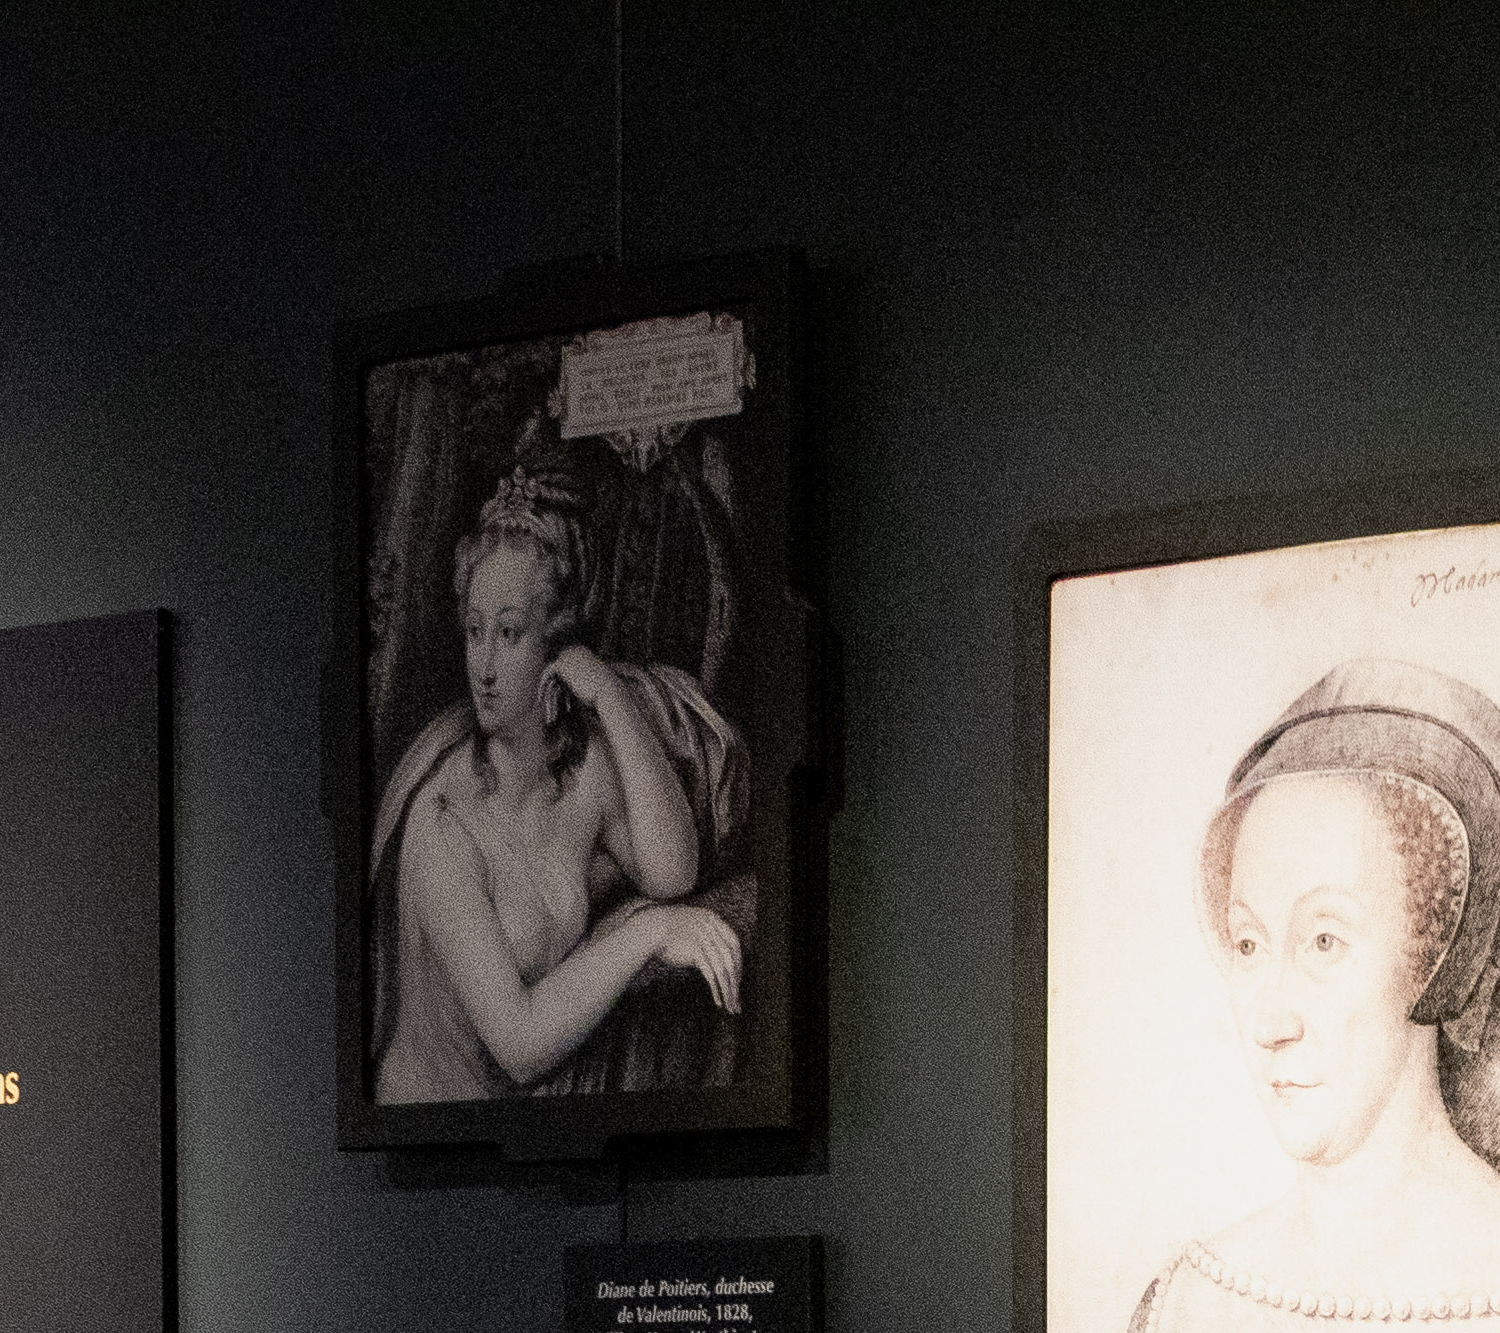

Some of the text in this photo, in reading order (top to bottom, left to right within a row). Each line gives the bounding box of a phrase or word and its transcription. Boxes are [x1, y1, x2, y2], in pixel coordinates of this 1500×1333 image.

[598, 1276, 774, 1298] Diane de Poitiers, duchesse
[617, 1304, 753, 1323] de Valentinois, 1828,
